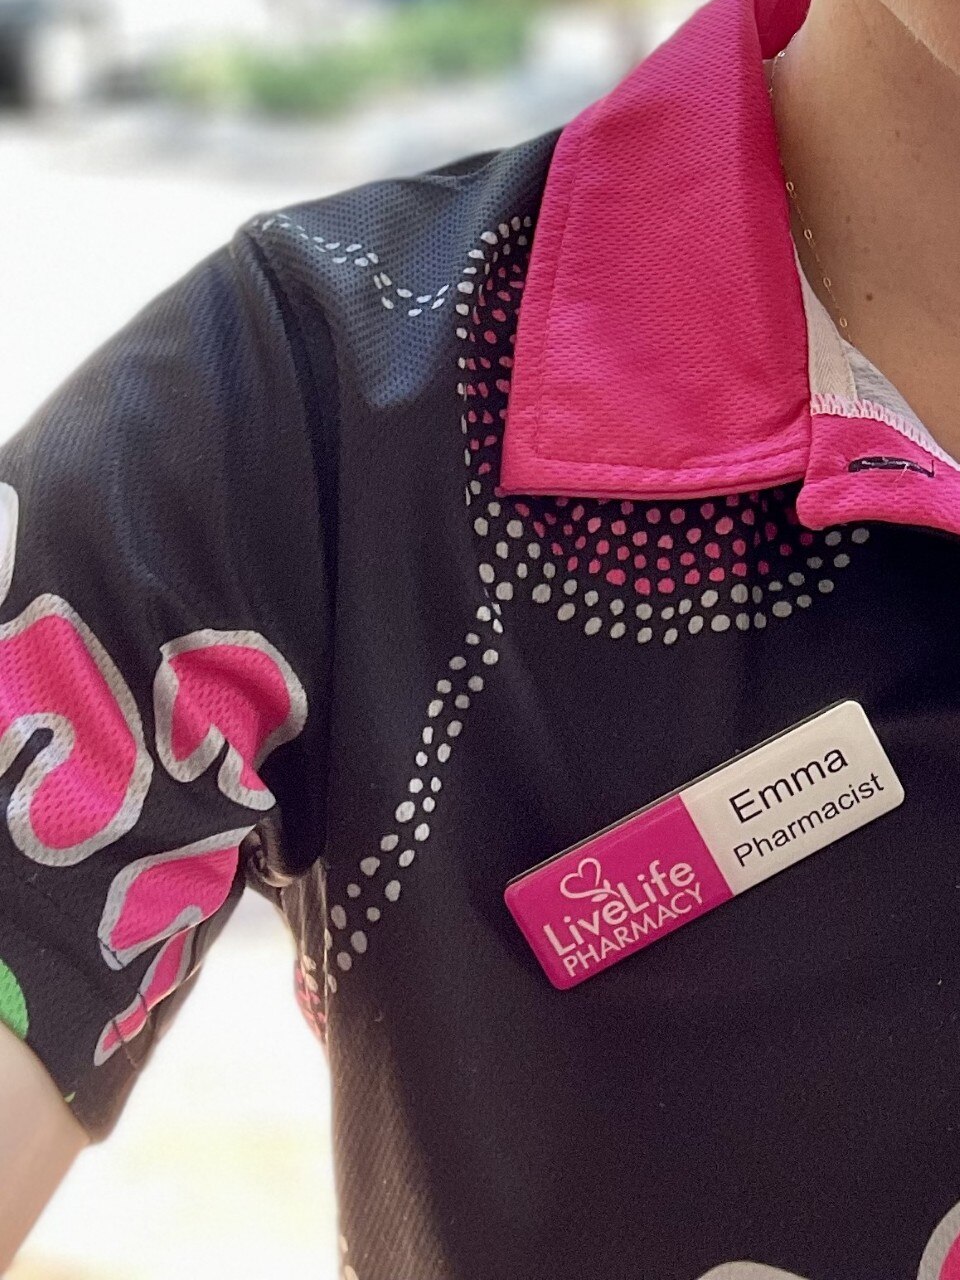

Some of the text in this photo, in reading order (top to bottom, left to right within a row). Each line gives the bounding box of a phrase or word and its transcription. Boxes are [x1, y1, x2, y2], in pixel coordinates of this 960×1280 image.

[729, 747, 849, 823] Emma
[733, 773, 885, 867] Pharmacist
[543, 859, 695, 956] LiveLife
[562, 882, 704, 977] PHARMACY
